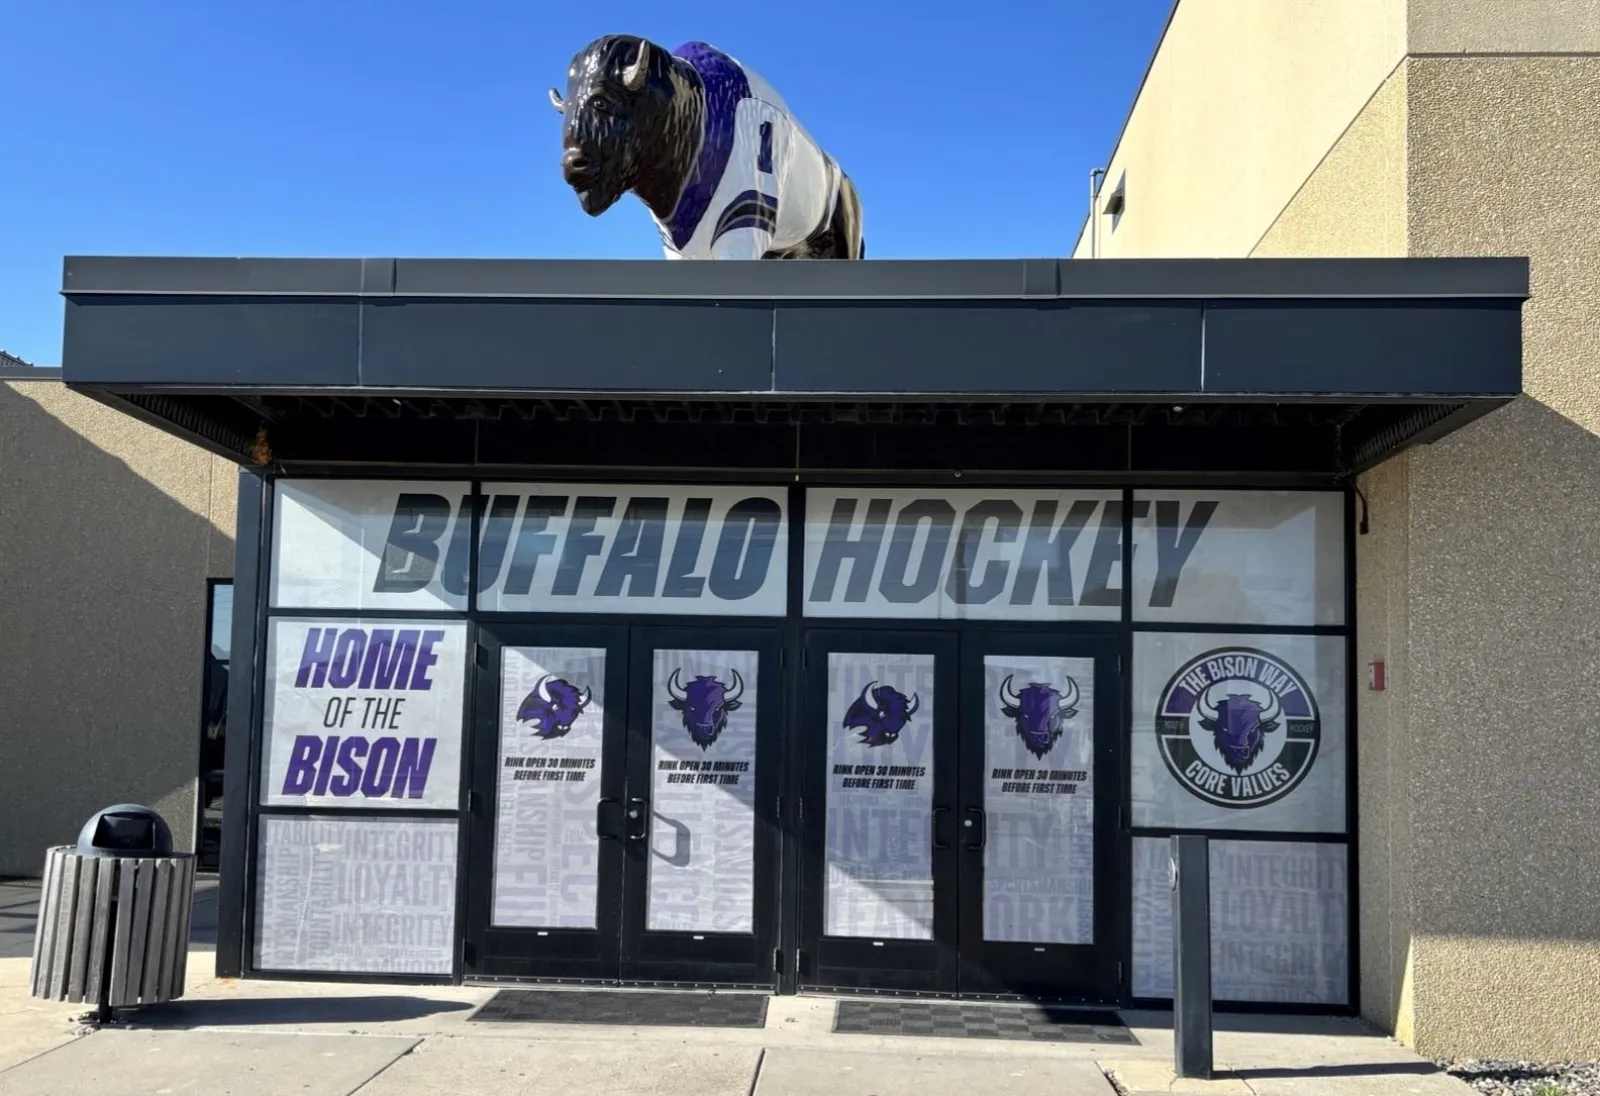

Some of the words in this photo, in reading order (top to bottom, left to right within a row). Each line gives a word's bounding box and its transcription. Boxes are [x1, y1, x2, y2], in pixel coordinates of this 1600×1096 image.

[757, 121, 773, 174] 1
[373, 493, 782, 600] BUFFALO
[808, 499, 1220, 607] HOCKEY
[294, 628, 445, 690] HOME
[1179, 666, 1211, 695] THE
[1207, 657, 1258, 681] BISON
[1259, 663, 1298, 698] WAY
[323, 697, 356, 728] OF
[361, 698, 406, 729] THE
[281, 735, 438, 799] BISON
[504, 757, 525, 768] RINK
[525, 758, 547, 768] OPEN
[547, 758, 559, 769] 30
[559, 758, 596, 769] MINUTES
[658, 760, 679, 770] RINK
[679, 761, 701, 771] OPEN
[701, 761, 712, 772] 30
[712, 761, 750, 772] MINUTES
[513, 770, 542, 780] BEFORE
[542, 771, 565, 781] FIRST
[565, 771, 586, 782] TIME
[833, 764, 854, 774] RINK
[854, 765, 876, 775] OPEN
[876, 765, 888, 776] 30
[888, 766, 926, 777] MINUTES
[991, 768, 1013, 779] RINK
[1013, 769, 1036, 780] OPEN
[1036, 770, 1048, 780] 30
[1048, 770, 1087, 781] MINUTES
[667, 773, 696, 784] BEFORE
[696, 774, 719, 784] FIRST
[719, 774, 740, 785] TIME
[842, 778, 871, 788] BEFORE
[871, 778, 894, 789] FIRST
[895, 779, 916, 790] TIME
[1185, 760, 1228, 795] CORE
[1231, 762, 1290, 797] VALUES
[1001, 782, 1031, 793] BEFORE
[1031, 783, 1055, 794] FIRST
[1055, 783, 1078, 794] TIME
